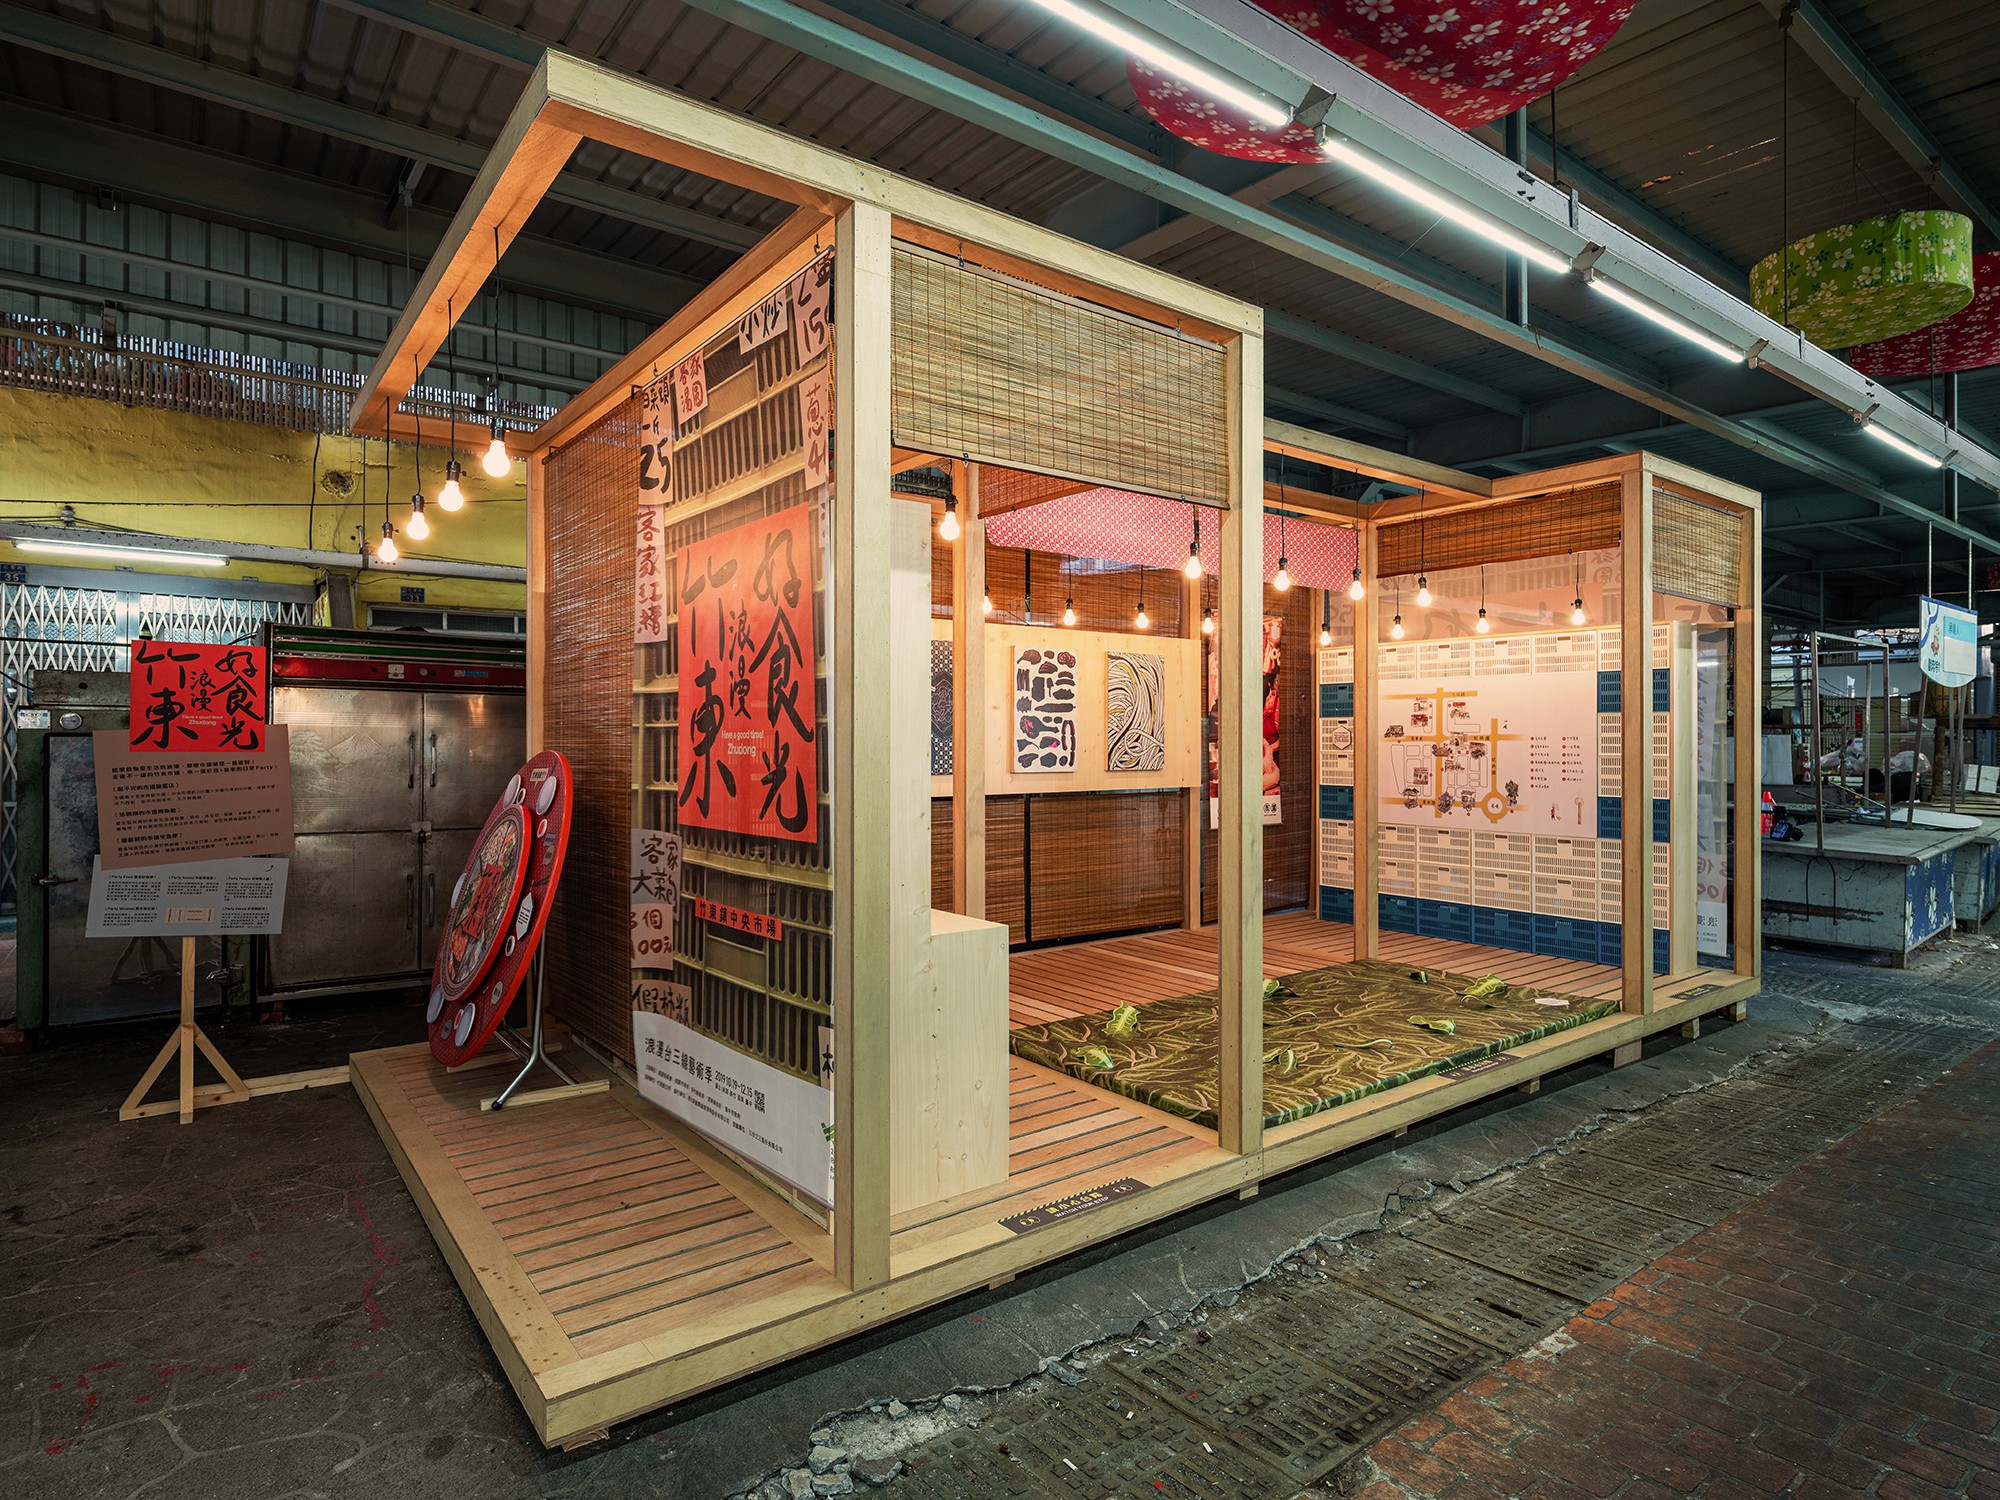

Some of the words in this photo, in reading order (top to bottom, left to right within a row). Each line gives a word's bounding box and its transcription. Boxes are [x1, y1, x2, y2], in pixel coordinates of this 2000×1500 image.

[740, 296, 784, 345] 小炒
[803, 303, 830, 354] 15
[640, 436, 672, 494] 25
[807, 439, 827, 476] 4
[4, 573, 20, 582] 35
[679, 548, 738, 820] 竹東
[728, 599, 756, 720] 浪漫
[748, 529, 815, 833] 好食光
[131, 641, 201, 750] 竹東
[190, 668, 217, 713] 浪漫
[211, 649, 265, 751] 好食光
[721, 730, 733, 739] Have
[736, 730, 750, 741] good
[750, 729, 765, 739] time!
[727, 742, 757, 758] Zhudong
[641, 834, 679, 871] 客家
[700, 901, 776, 937] 竹東鎮中央市場
